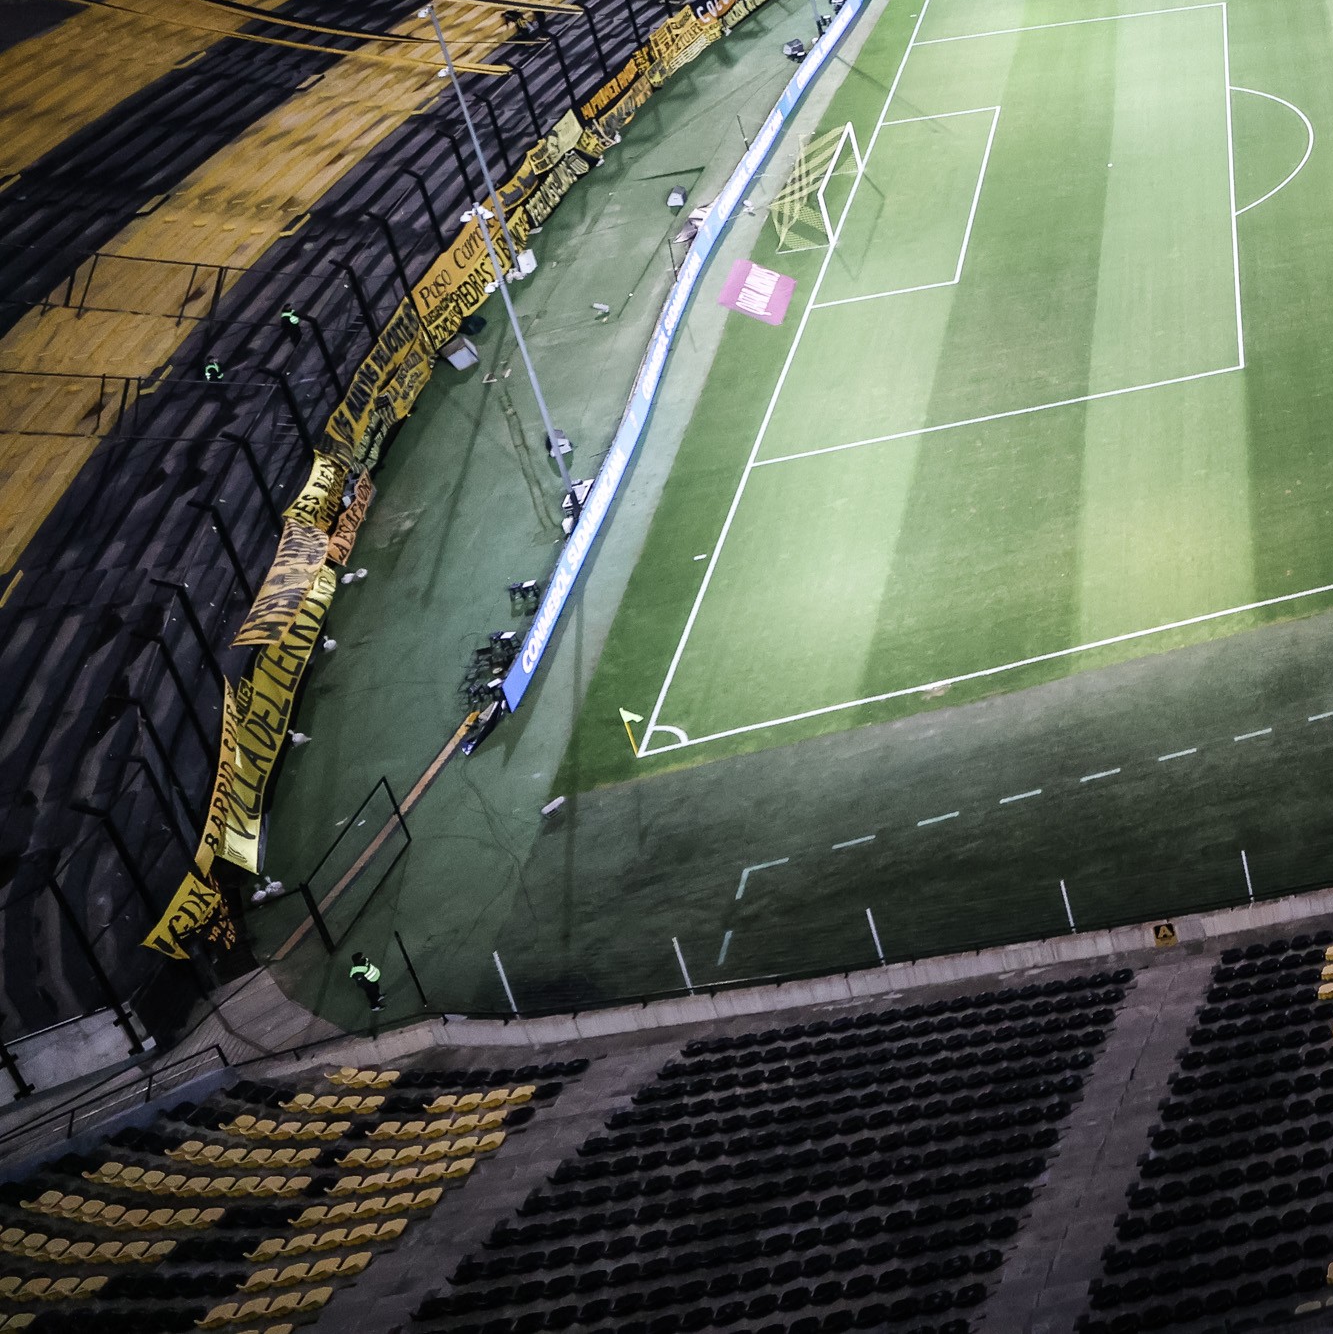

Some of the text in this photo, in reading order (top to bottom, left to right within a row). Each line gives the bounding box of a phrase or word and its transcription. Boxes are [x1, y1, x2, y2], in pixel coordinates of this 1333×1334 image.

[418, 269, 452, 310] Paso
[521, 448, 627, 674] CONMEBOL SUDAMERICANA
[244, 688, 291, 752] DEL
[1156, 924, 1174, 939] A
